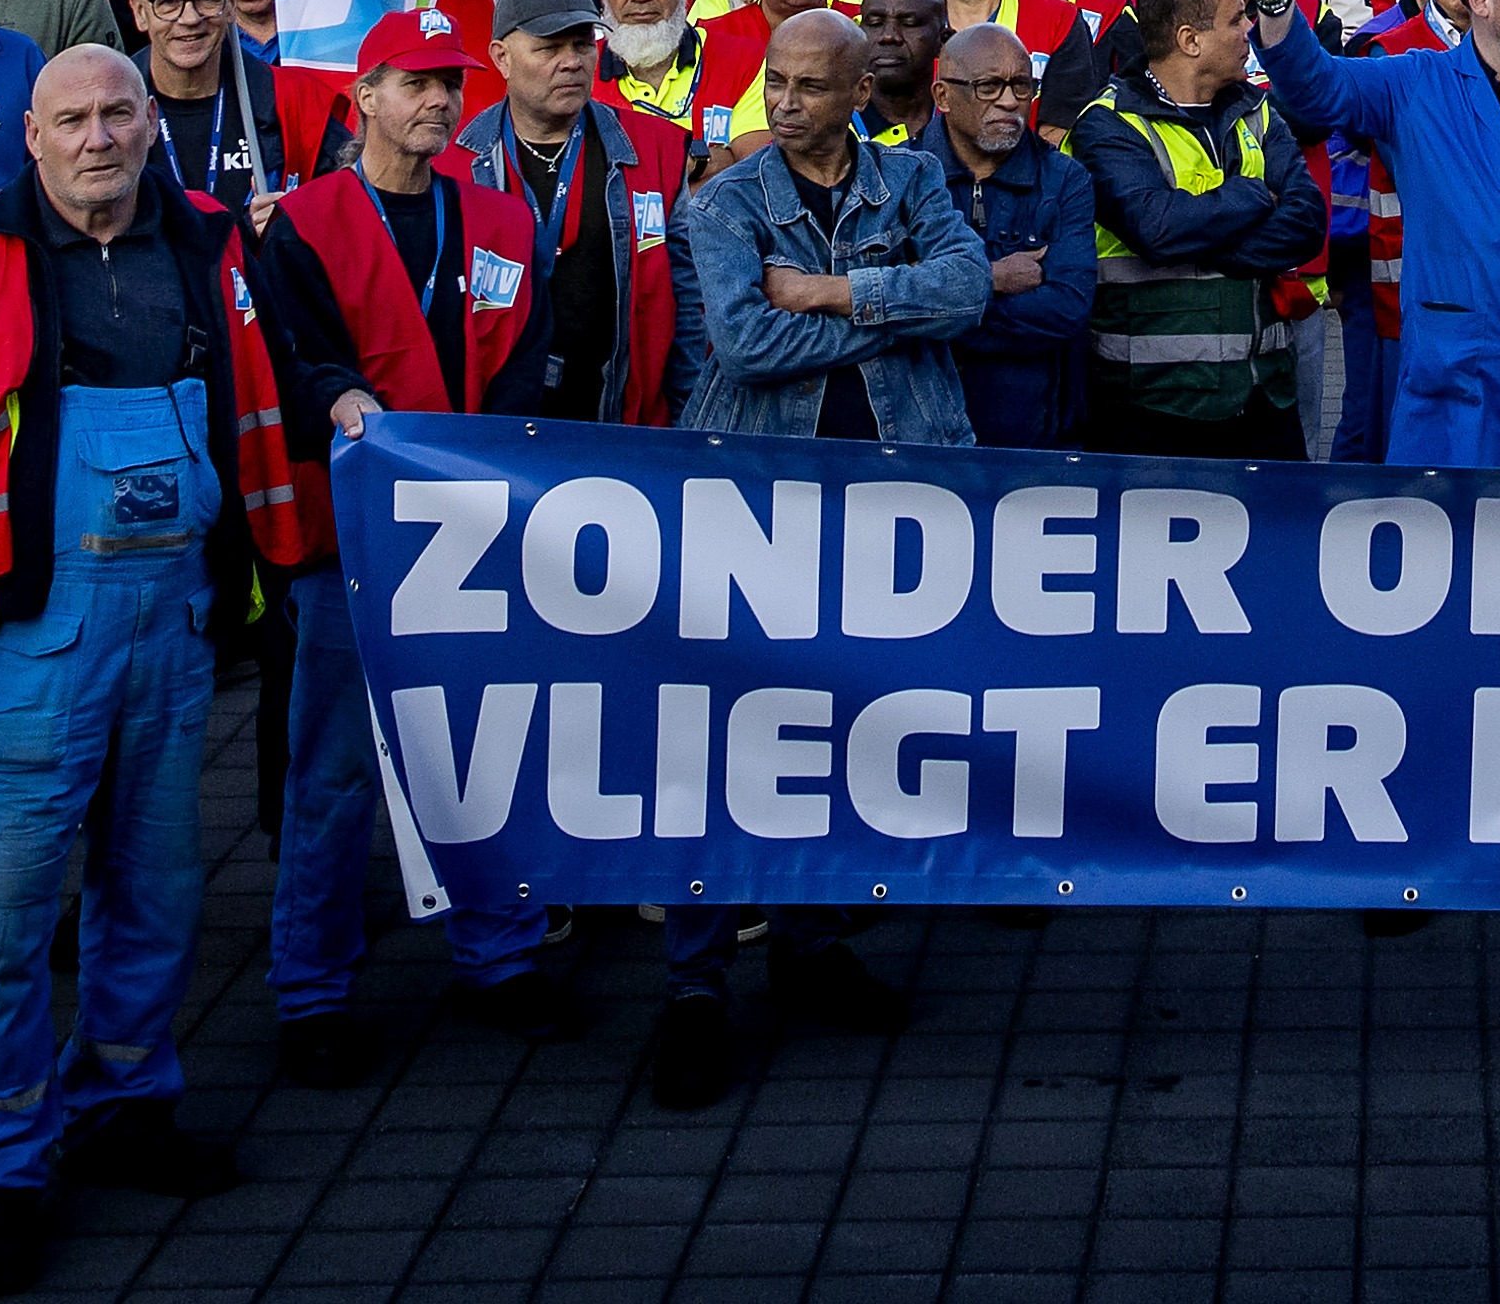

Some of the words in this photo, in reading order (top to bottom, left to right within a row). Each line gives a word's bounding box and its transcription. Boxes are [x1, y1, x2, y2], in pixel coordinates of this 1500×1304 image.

[421, 12, 450, 32] FNV
[703, 110, 731, 140] FN
[223, 152, 252, 171] KL
[634, 196, 665, 235] FN
[473, 254, 521, 299] FNV
[392, 478, 1253, 640] ZONDER
[392, 683, 1102, 844] VLIEGT
[1156, 684, 1409, 844] ER
